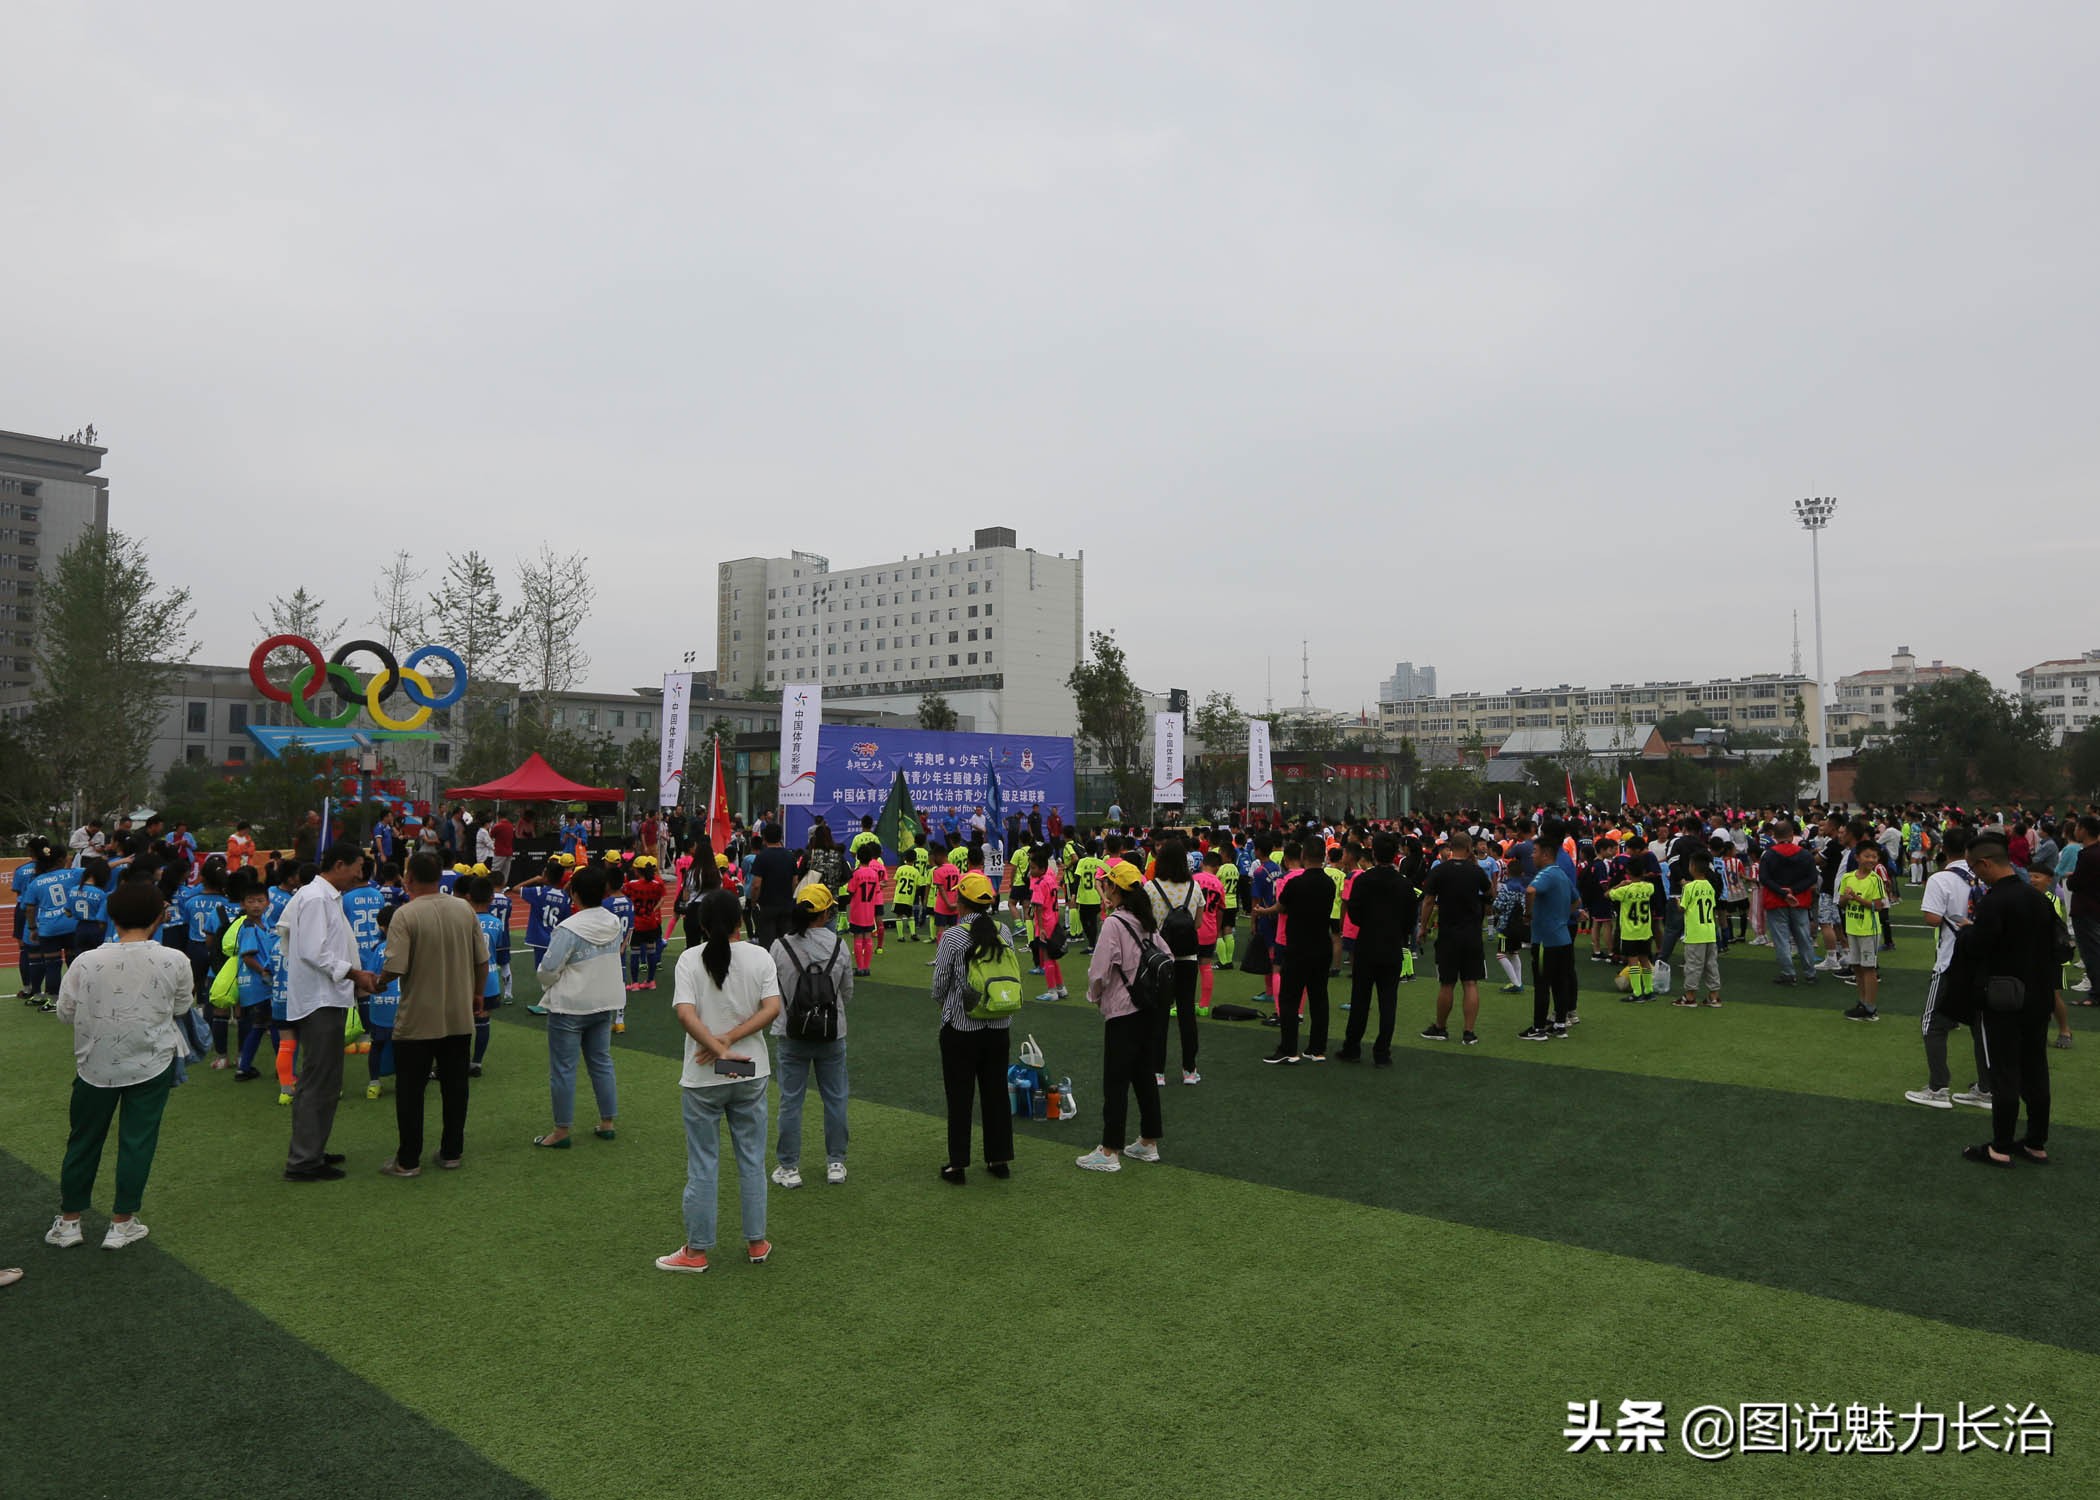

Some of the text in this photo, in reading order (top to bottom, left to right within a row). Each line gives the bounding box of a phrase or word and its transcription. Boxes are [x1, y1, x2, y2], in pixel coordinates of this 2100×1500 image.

[791, 709, 804, 775] 中国体育彩票
[49, 884, 67, 906] 8
[860, 882, 876, 902] 17
[899, 878, 914, 895] 25
[542, 905, 560, 928] 16
[1628, 900, 1649, 926] 49
[1696, 898, 1713, 924] 12
